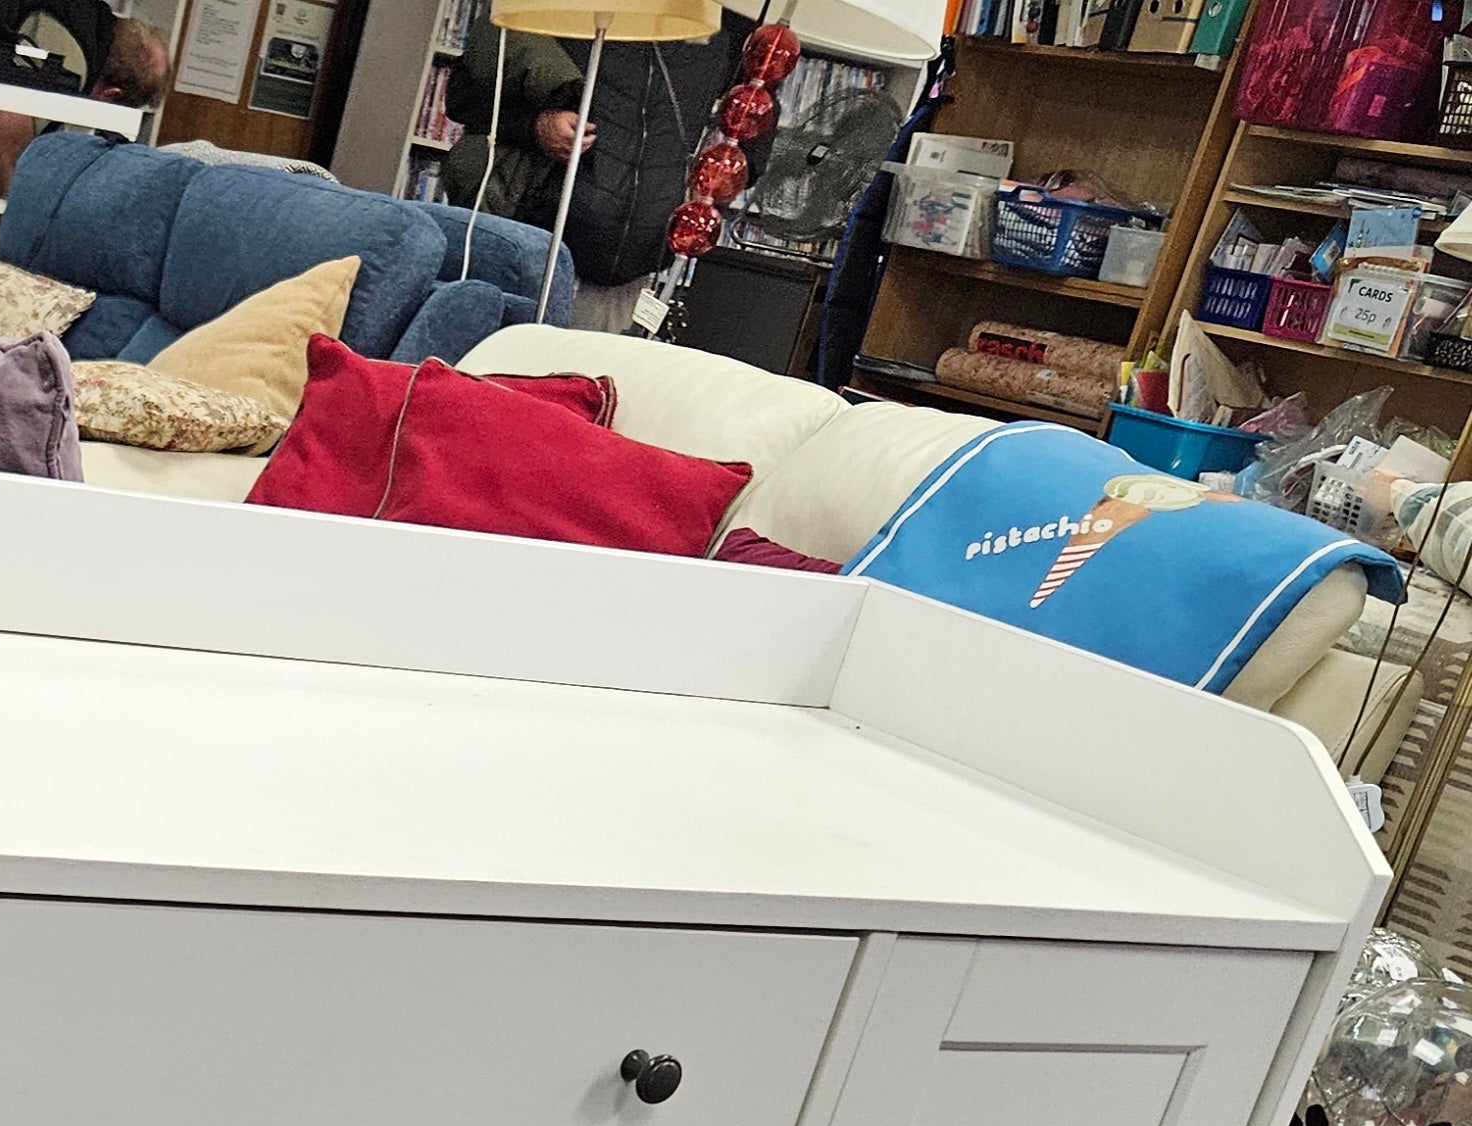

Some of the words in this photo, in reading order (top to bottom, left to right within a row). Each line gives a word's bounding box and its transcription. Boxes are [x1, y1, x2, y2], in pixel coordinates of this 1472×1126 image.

[1358, 286, 1393, 302] CARDS
[1354, 307, 1376, 325] 25p
[965, 514, 1113, 560] pistachio
